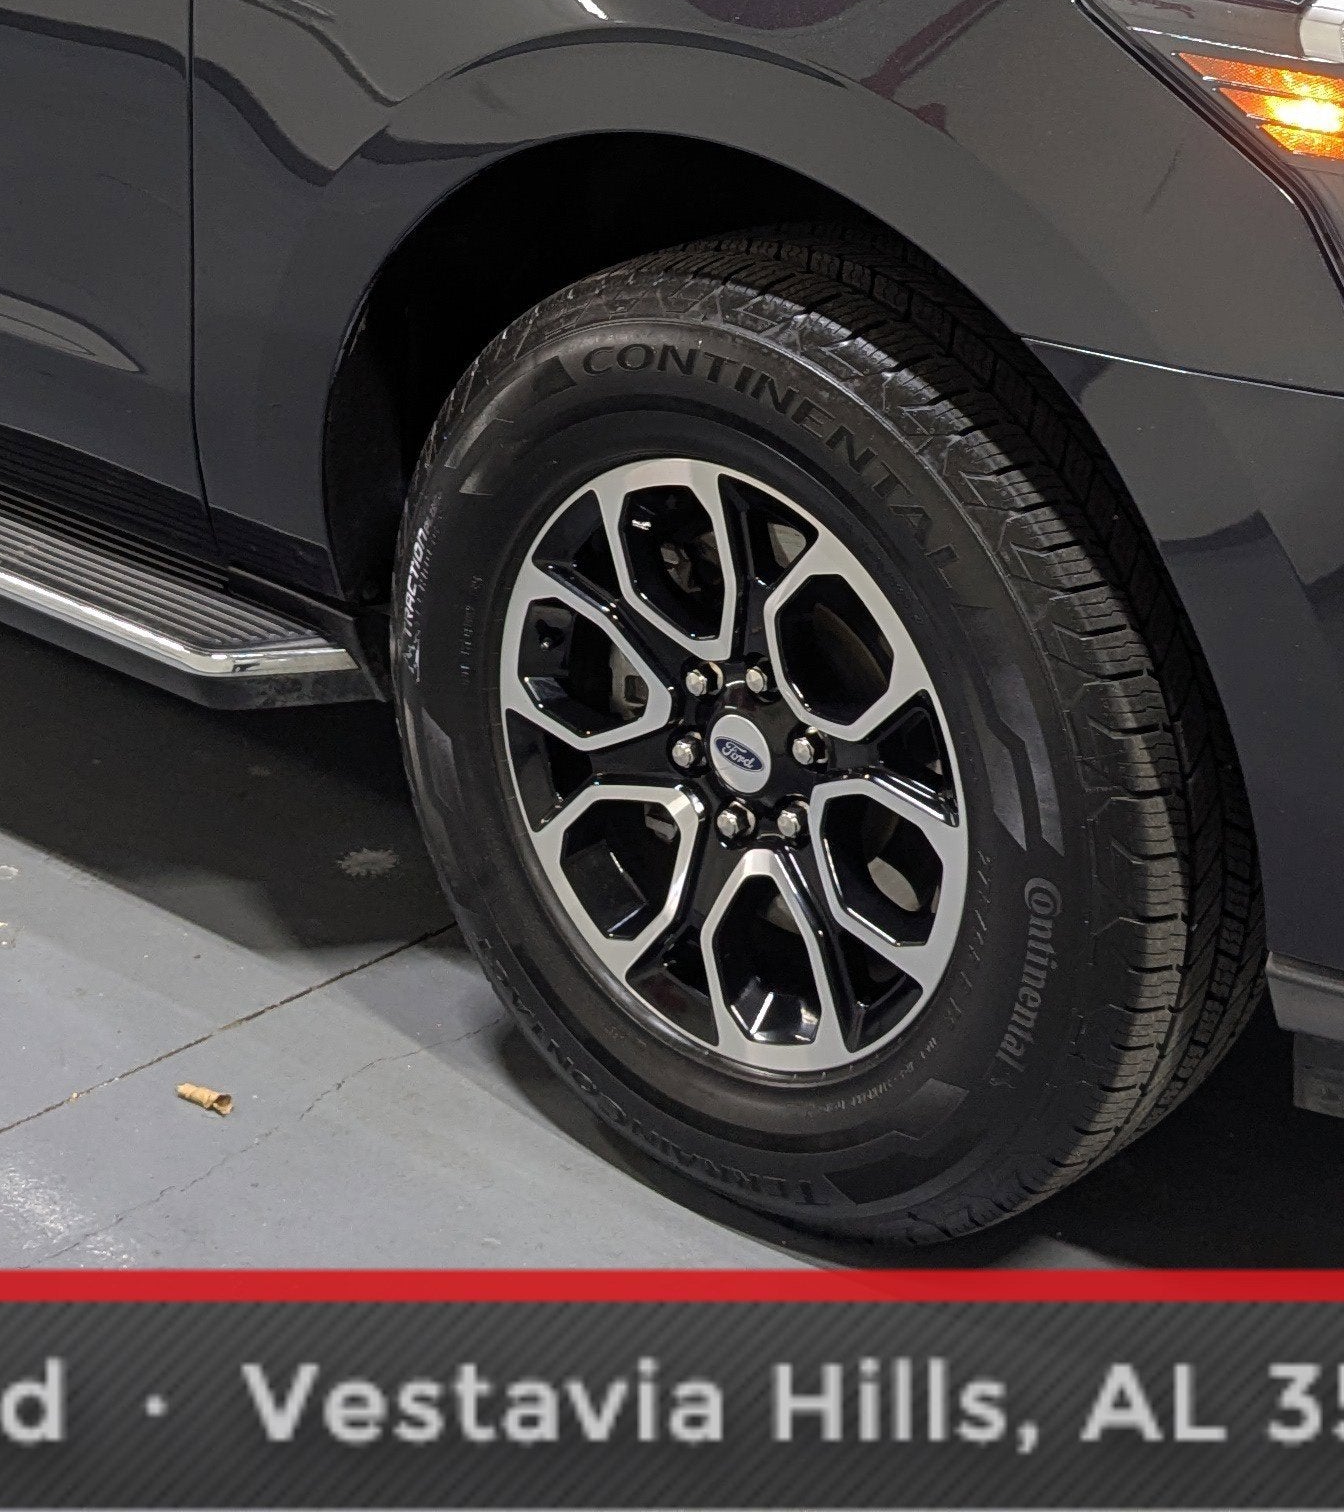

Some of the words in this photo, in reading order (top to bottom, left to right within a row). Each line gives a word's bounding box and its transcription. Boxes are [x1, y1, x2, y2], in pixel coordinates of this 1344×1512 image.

[582, 342, 960, 590] CONTINENTAL
[404, 526, 430, 638] TRACTION
[721, 741, 756, 769] Ford
[994, 876, 1063, 1074] Continental
